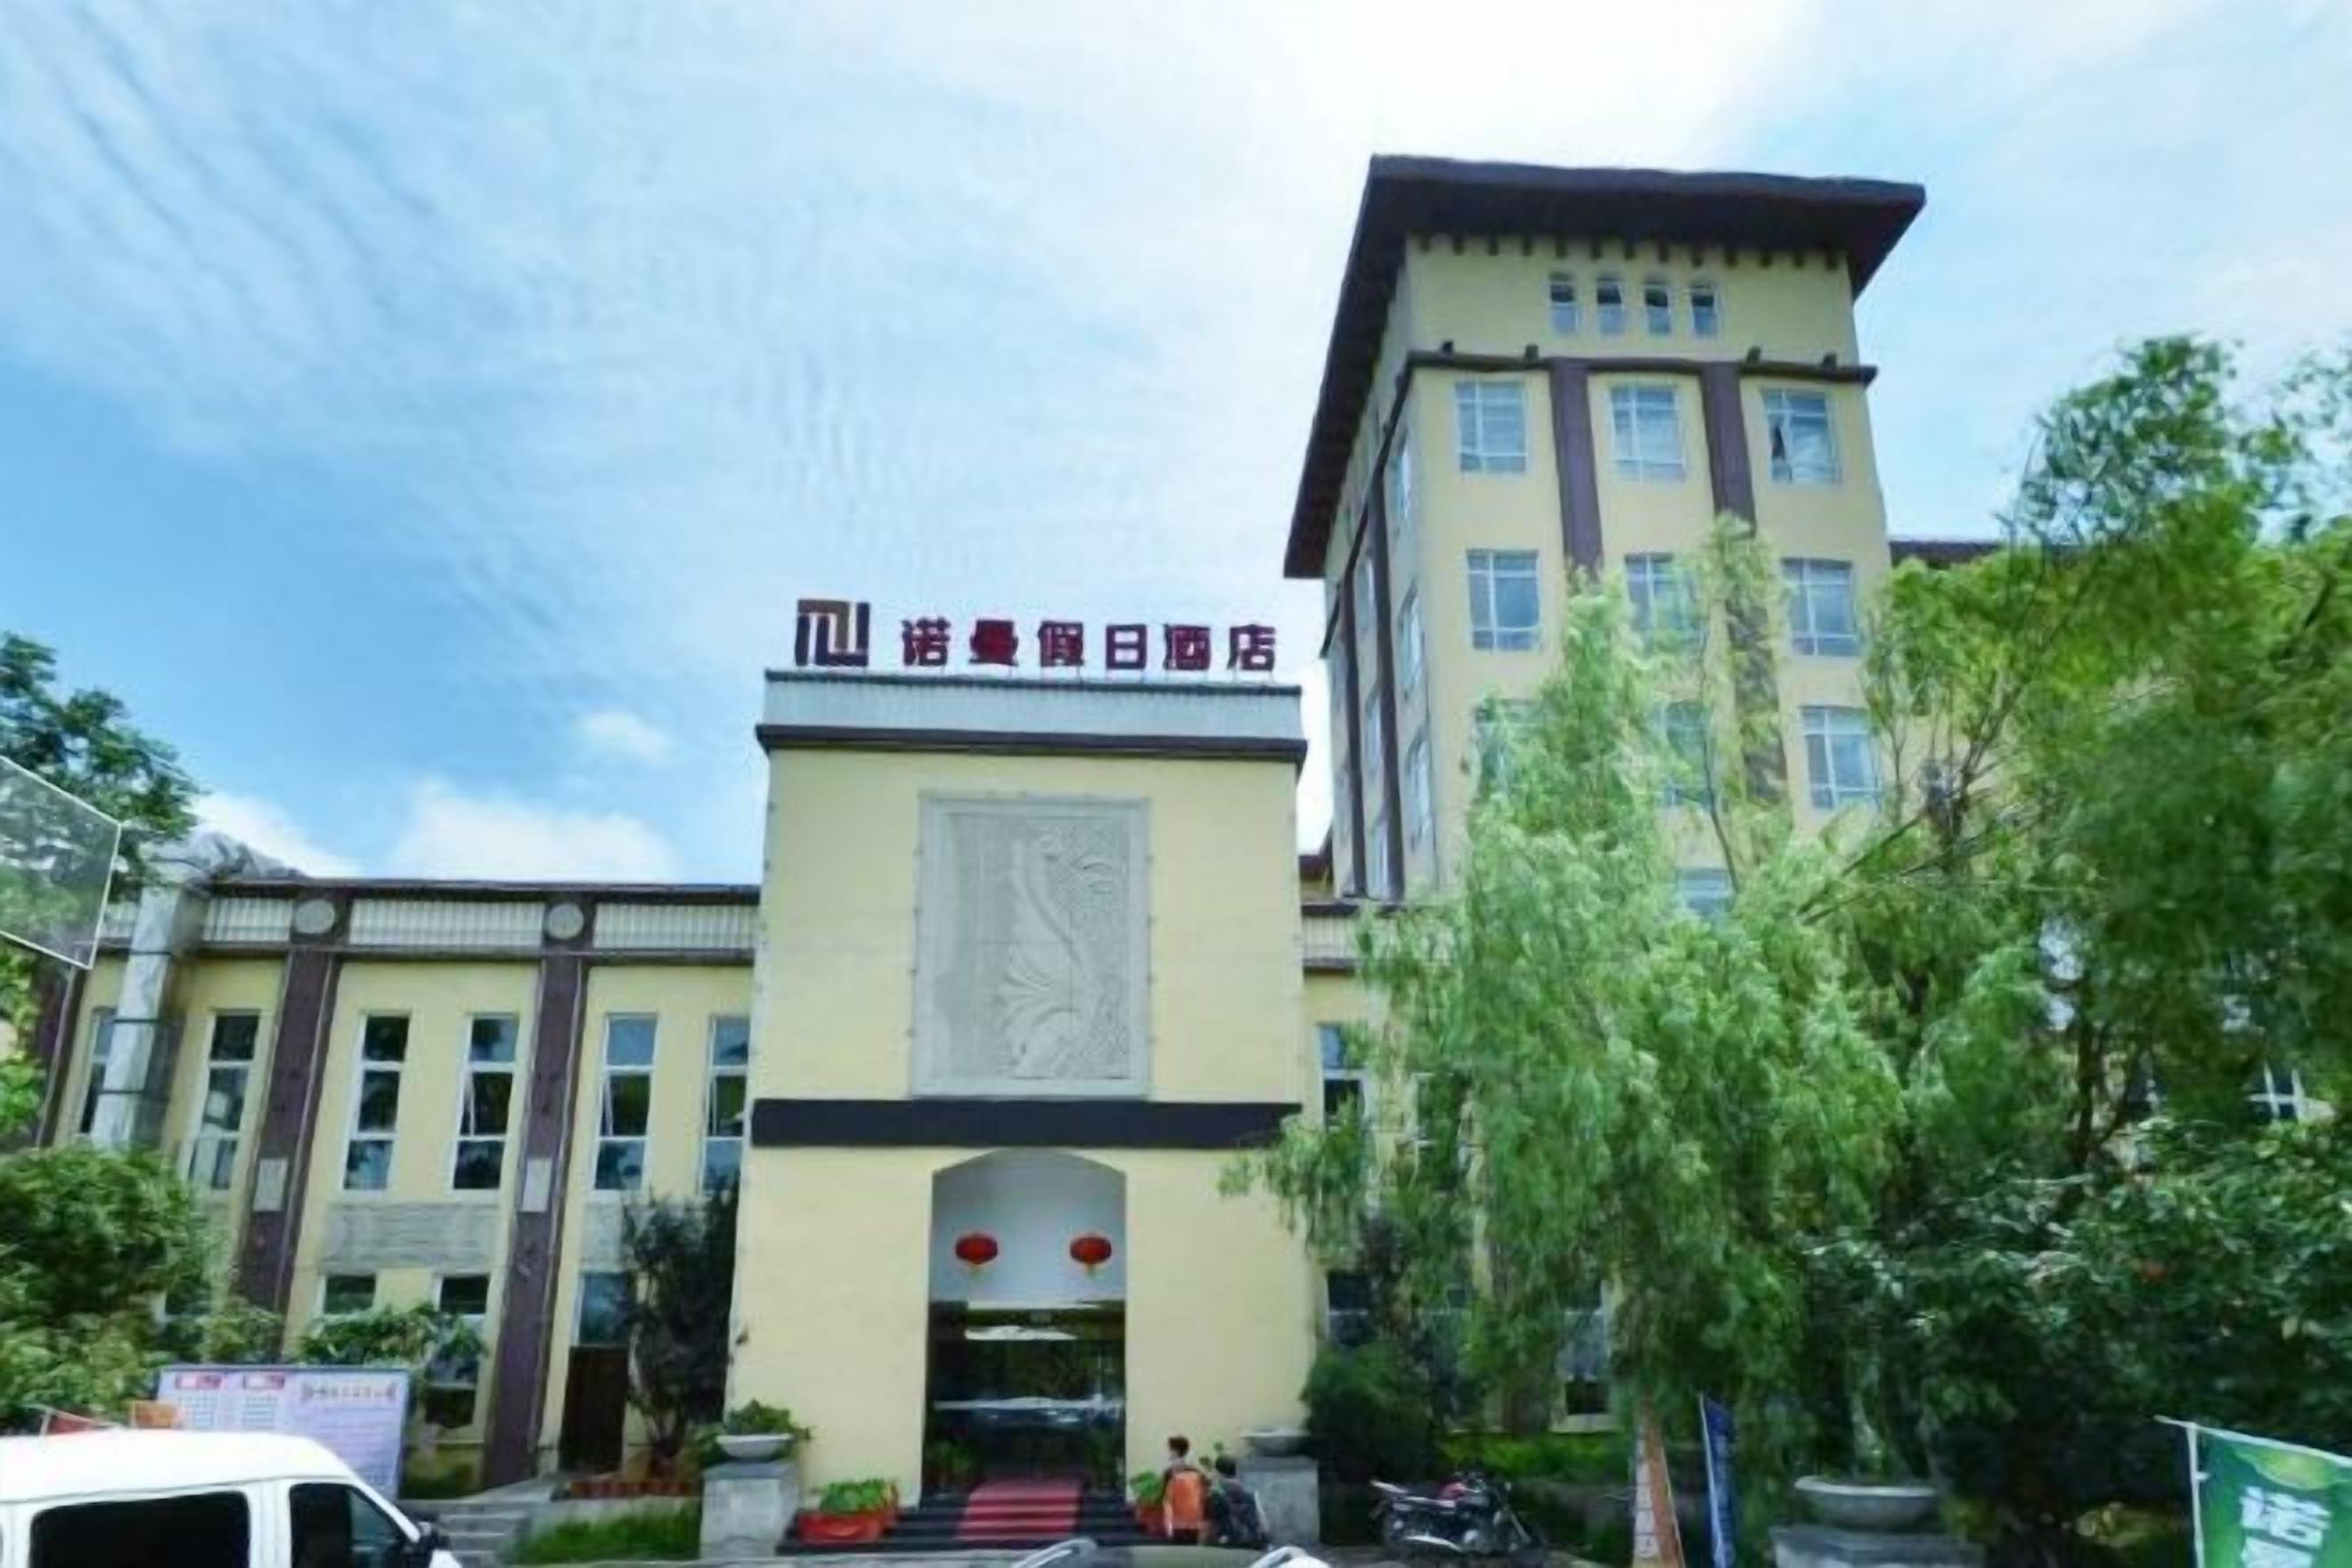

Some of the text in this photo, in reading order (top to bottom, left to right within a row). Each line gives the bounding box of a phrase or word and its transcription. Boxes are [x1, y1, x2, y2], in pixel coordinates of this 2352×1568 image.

[901, 616, 1277, 672] 诺曼假日酒店
